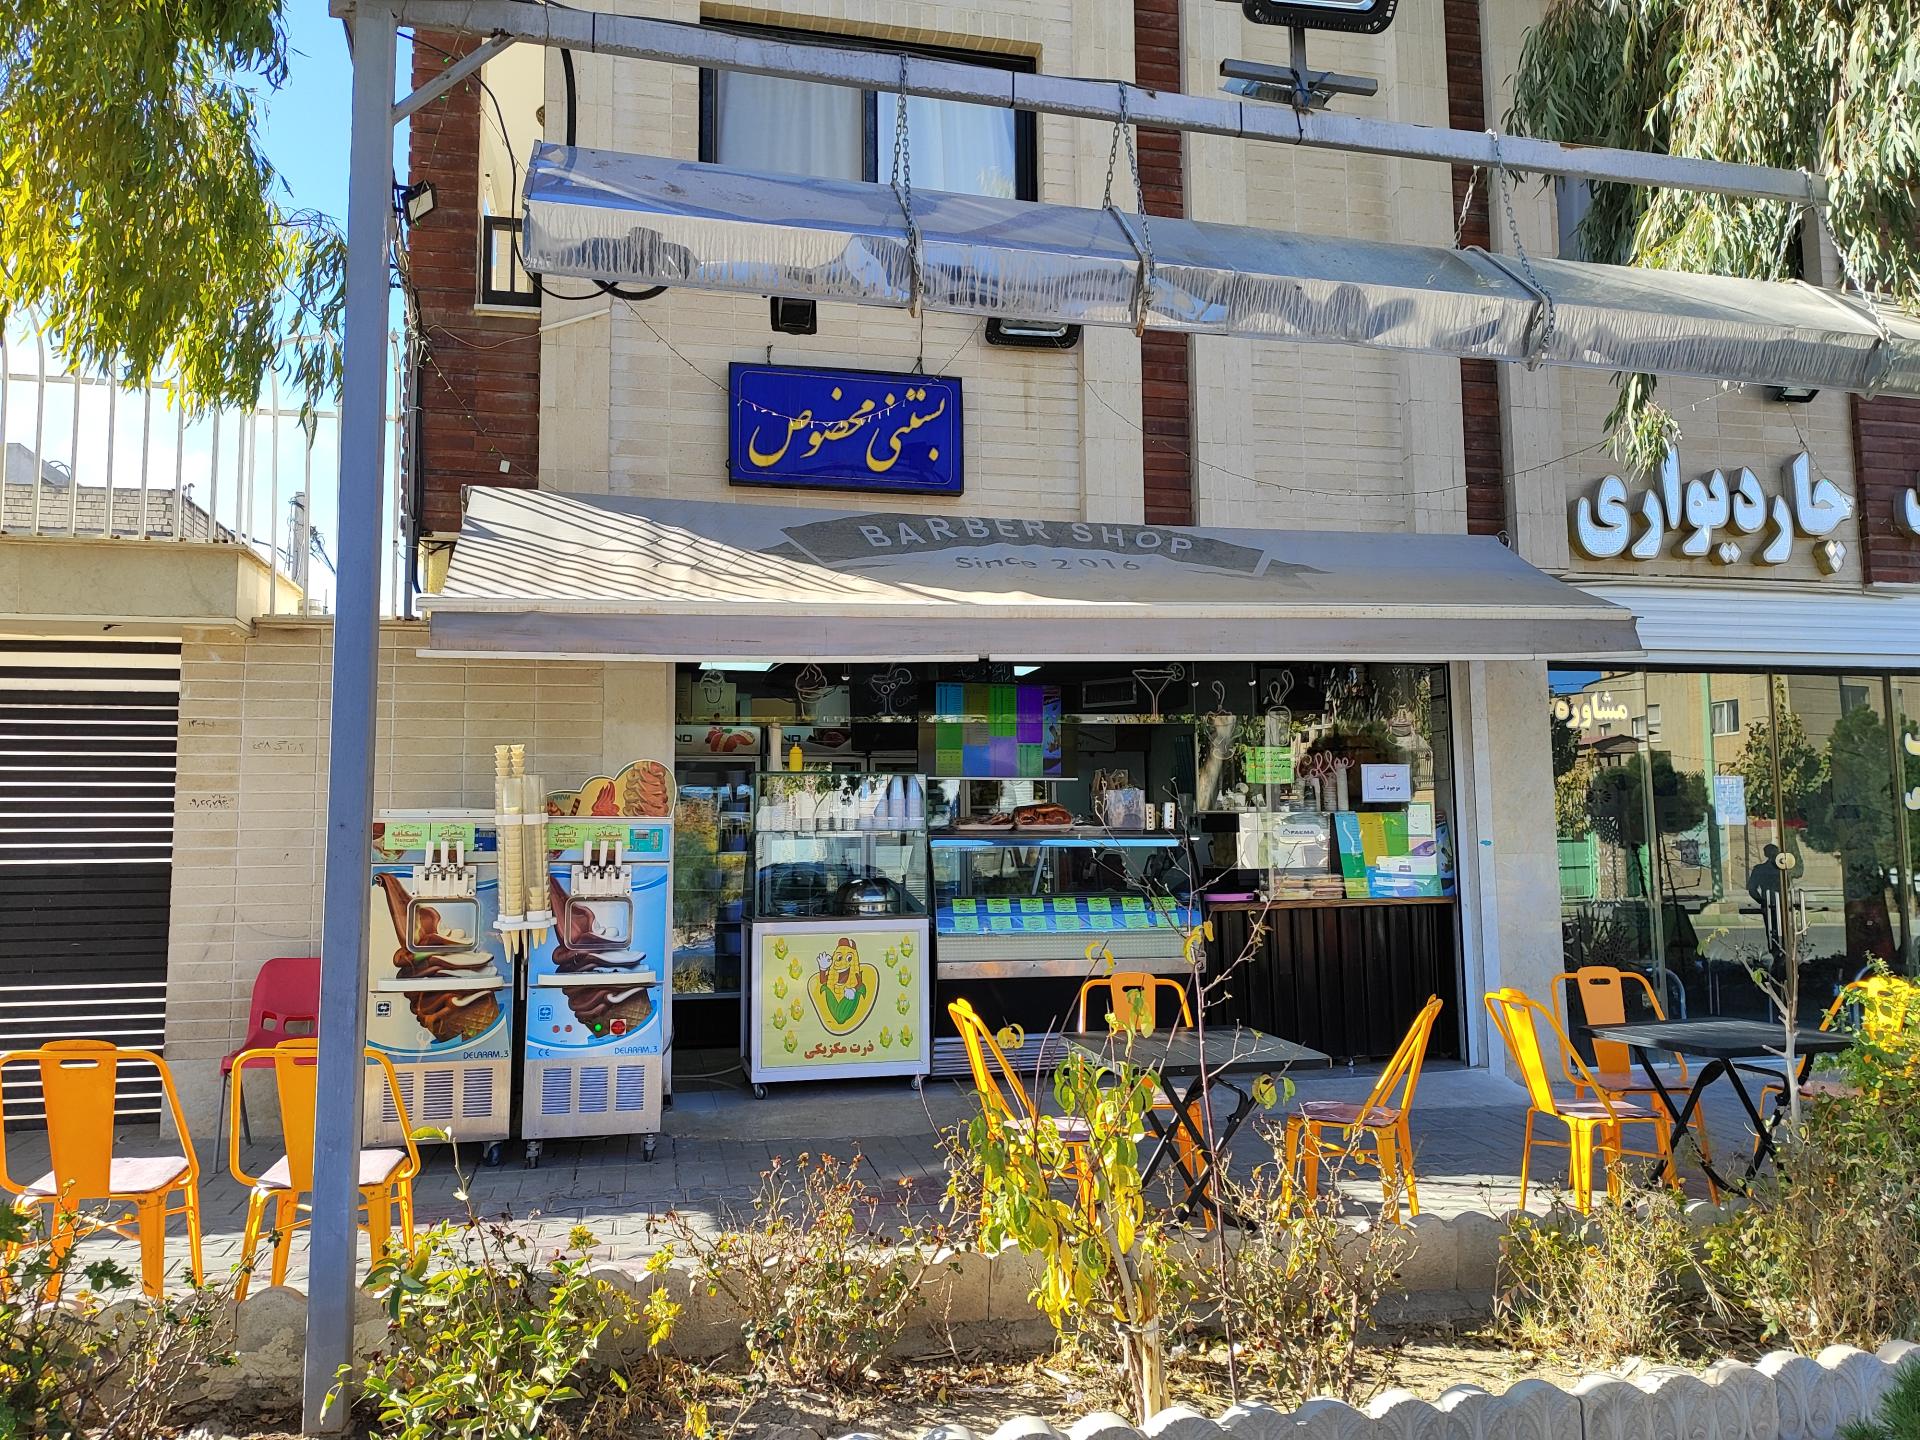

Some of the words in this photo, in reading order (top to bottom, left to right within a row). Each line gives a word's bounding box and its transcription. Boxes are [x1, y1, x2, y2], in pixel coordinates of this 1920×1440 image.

[748, 386, 876, 468] مخصوص
[866, 386, 946, 473] بستنی
[857, 516, 1051, 549] BARBER
[1071, 522, 1194, 556] SHOP
[953, 554, 1037, 571] Since
[1054, 557, 1141, 572] 2016
[1554, 690, 1629, 729] مشاوره
[803, 1041, 848, 1060] مکزیکی
[849, 1039, 875, 1057] ذرت
